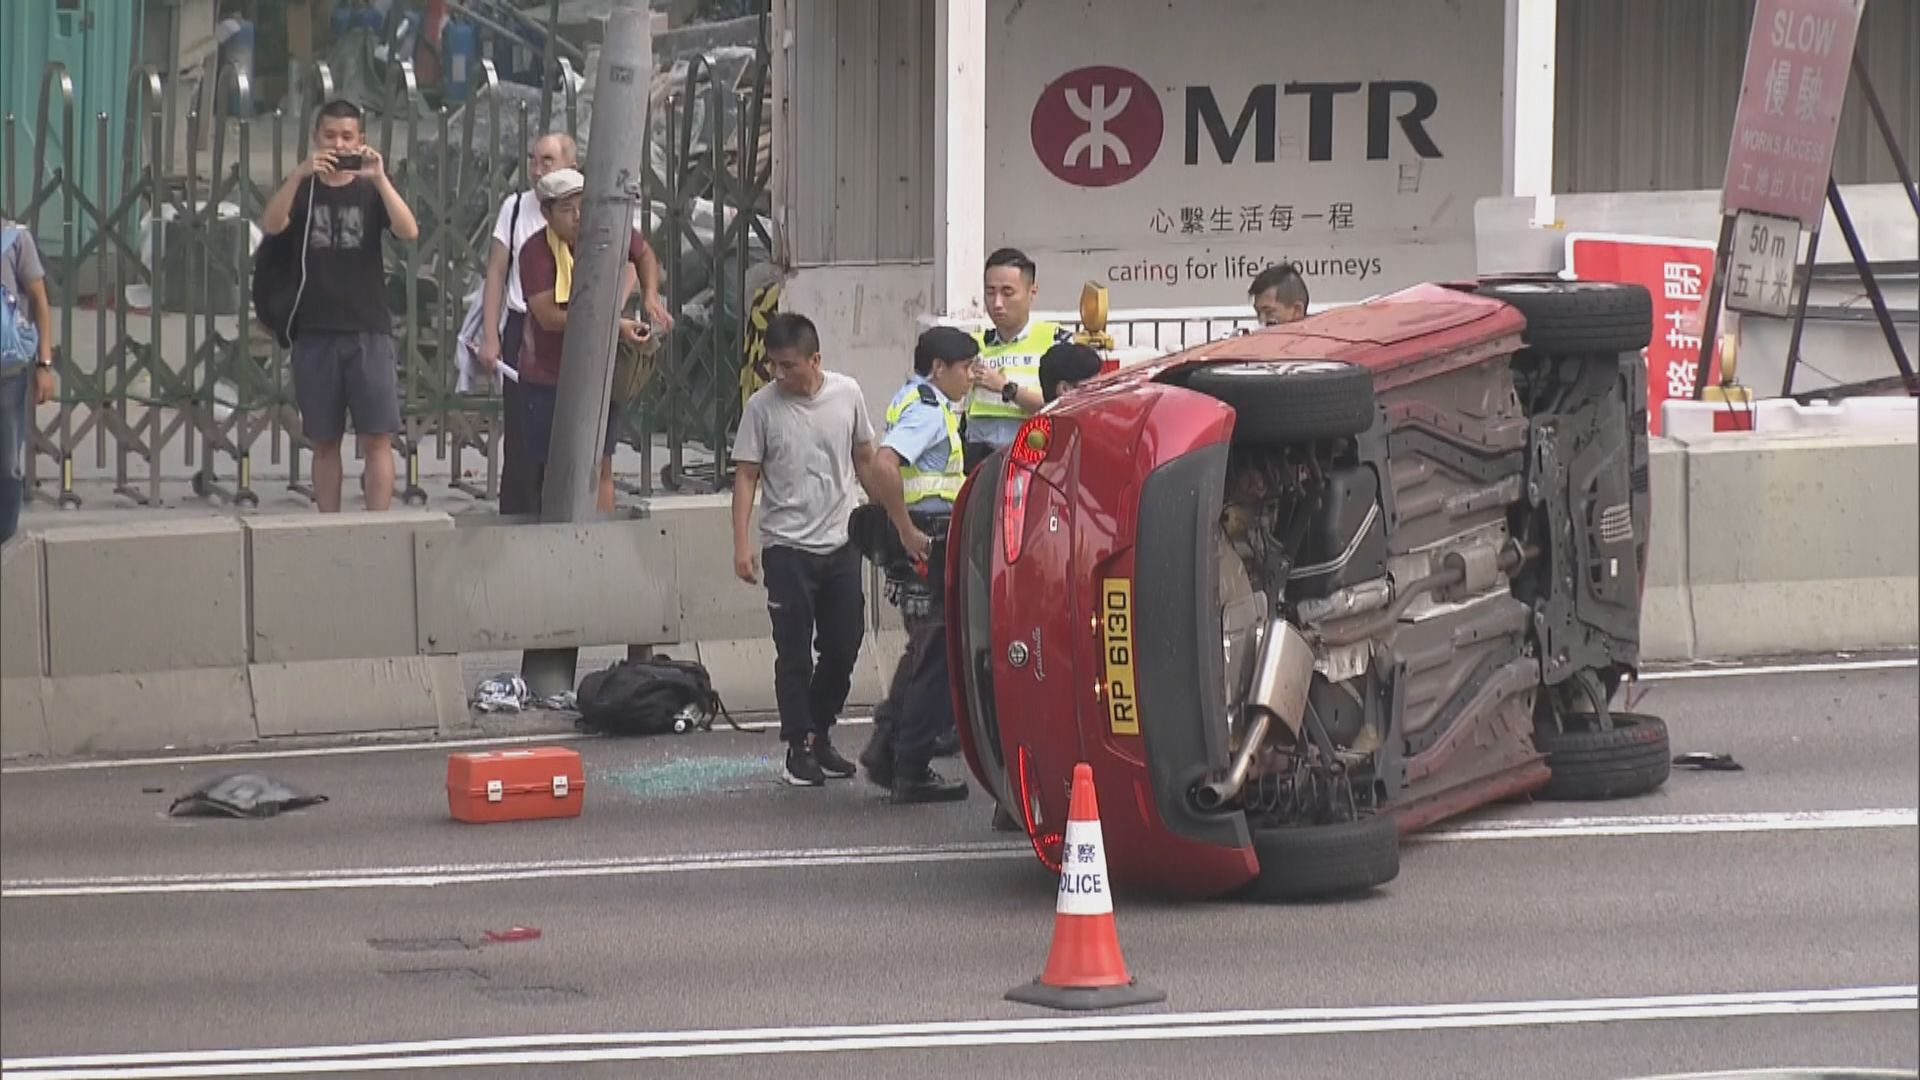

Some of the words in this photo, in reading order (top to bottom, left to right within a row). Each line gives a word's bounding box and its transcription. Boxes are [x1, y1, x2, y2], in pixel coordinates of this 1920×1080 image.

[1772, 8, 1837, 57] SLOW
[1764, 58, 1825, 122] 慢駛
[1184, 80, 1443, 166] MTR
[1741, 125, 1781, 155] WORKS
[1782, 137, 1825, 164] ACCESS
[1737, 163, 1816, 204] 工地出入口
[1150, 203, 1355, 234] 心繫生活每一程
[1749, 224, 1769, 255] 50
[1771, 235, 1786, 258] m
[1107, 260, 1178, 286] caring
[1185, 256, 1217, 280] for
[1733, 263, 1788, 305] 五十米
[1108, 591, 1129, 665] 6130
[1113, 680, 1134, 723] RP
[1060, 872, 1102, 894] OLICE
